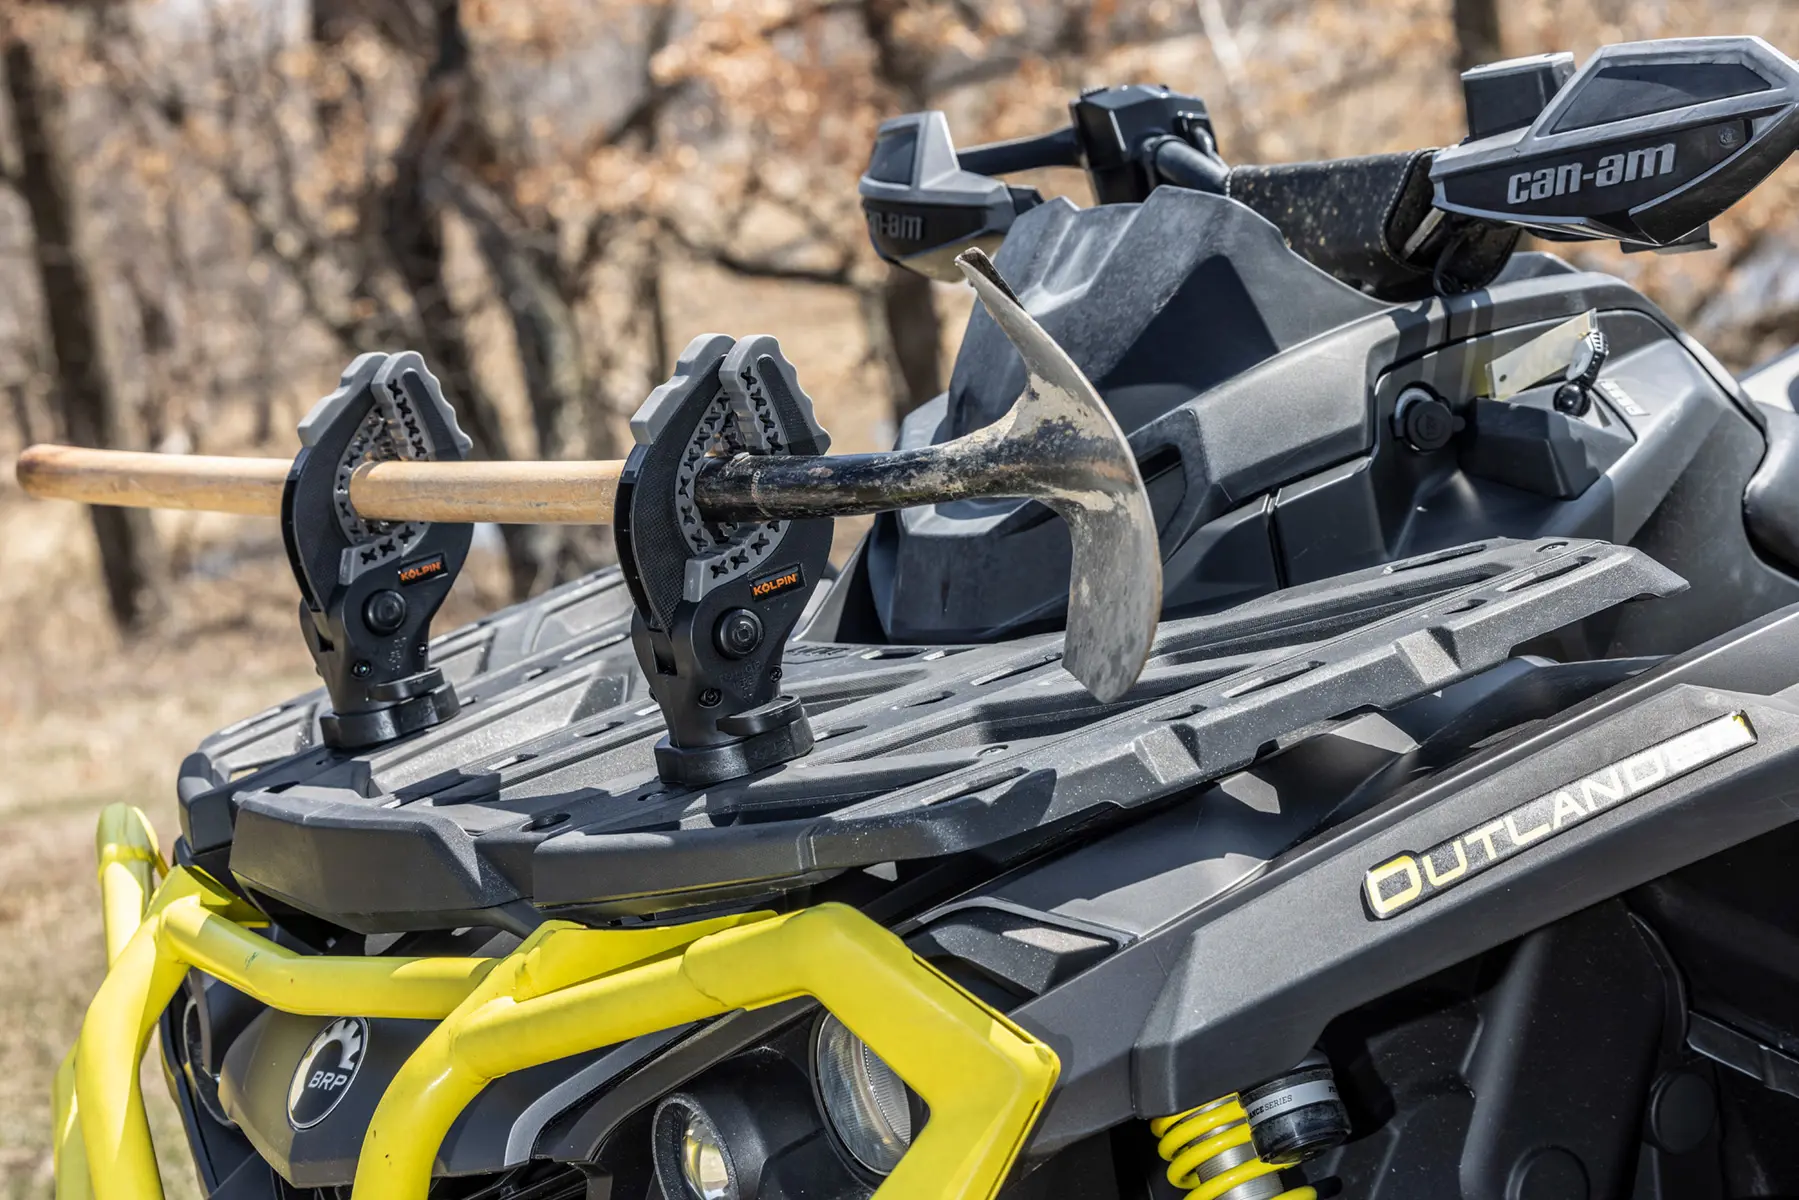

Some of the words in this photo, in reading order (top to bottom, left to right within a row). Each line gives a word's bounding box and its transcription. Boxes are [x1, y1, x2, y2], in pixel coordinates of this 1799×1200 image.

[1507, 142, 1676, 205] can-am
[752, 572, 798, 596] KOLPIN
[308, 1070, 348, 1091] BRP
[1264, 1094, 1293, 1111] SERIES
